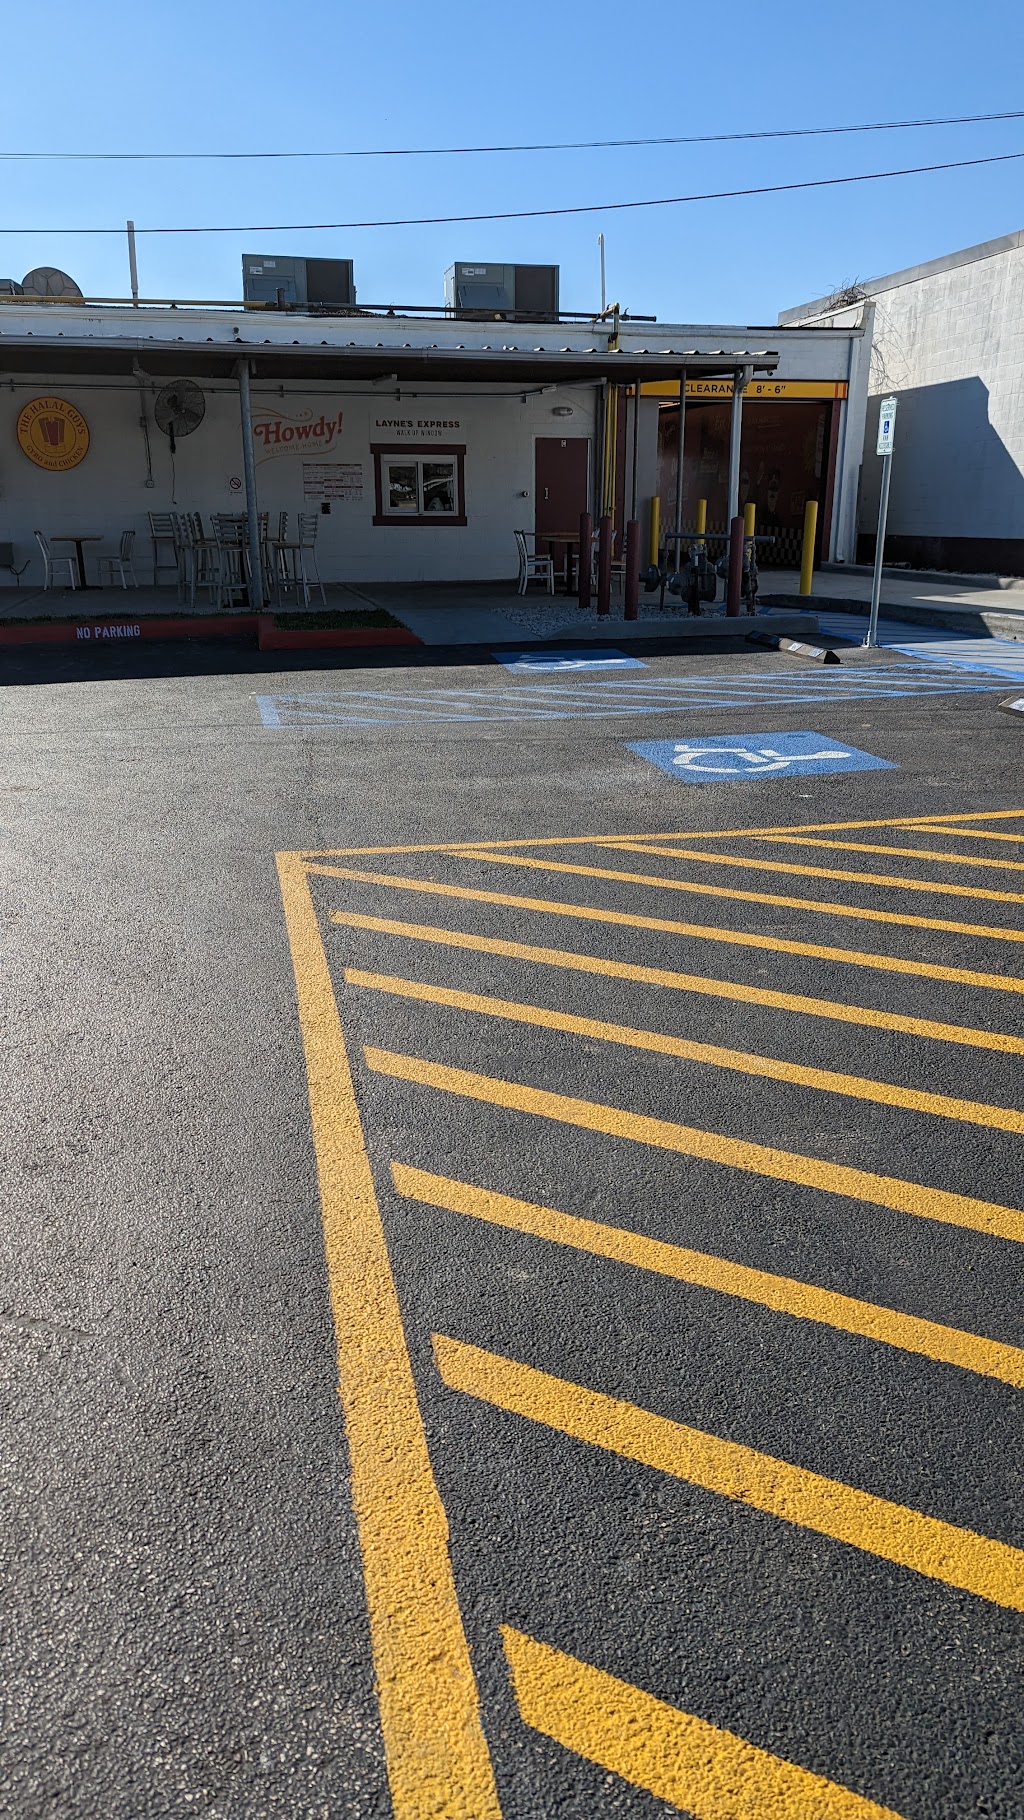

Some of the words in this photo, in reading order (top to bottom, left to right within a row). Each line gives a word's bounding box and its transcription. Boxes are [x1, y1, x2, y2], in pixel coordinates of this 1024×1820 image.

[685, 384, 748, 394] CLEARANE
[20, 412, 33, 434] THE
[30, 400, 65, 414] HALAL
[67, 409, 86, 435] GUYS
[375, 419, 414, 428] LAYNE'S
[417, 420, 461, 428] EXPRESS
[253, 411, 343, 446] Howdy!
[264, 444, 300, 455] WELCOME
[302, 440, 323, 449] HOME
[26, 445, 44, 462] GYRO
[58, 447, 84, 467] CHICKEN
[76, 626, 91, 639] NO
[94, 624, 141, 639] PARKING
